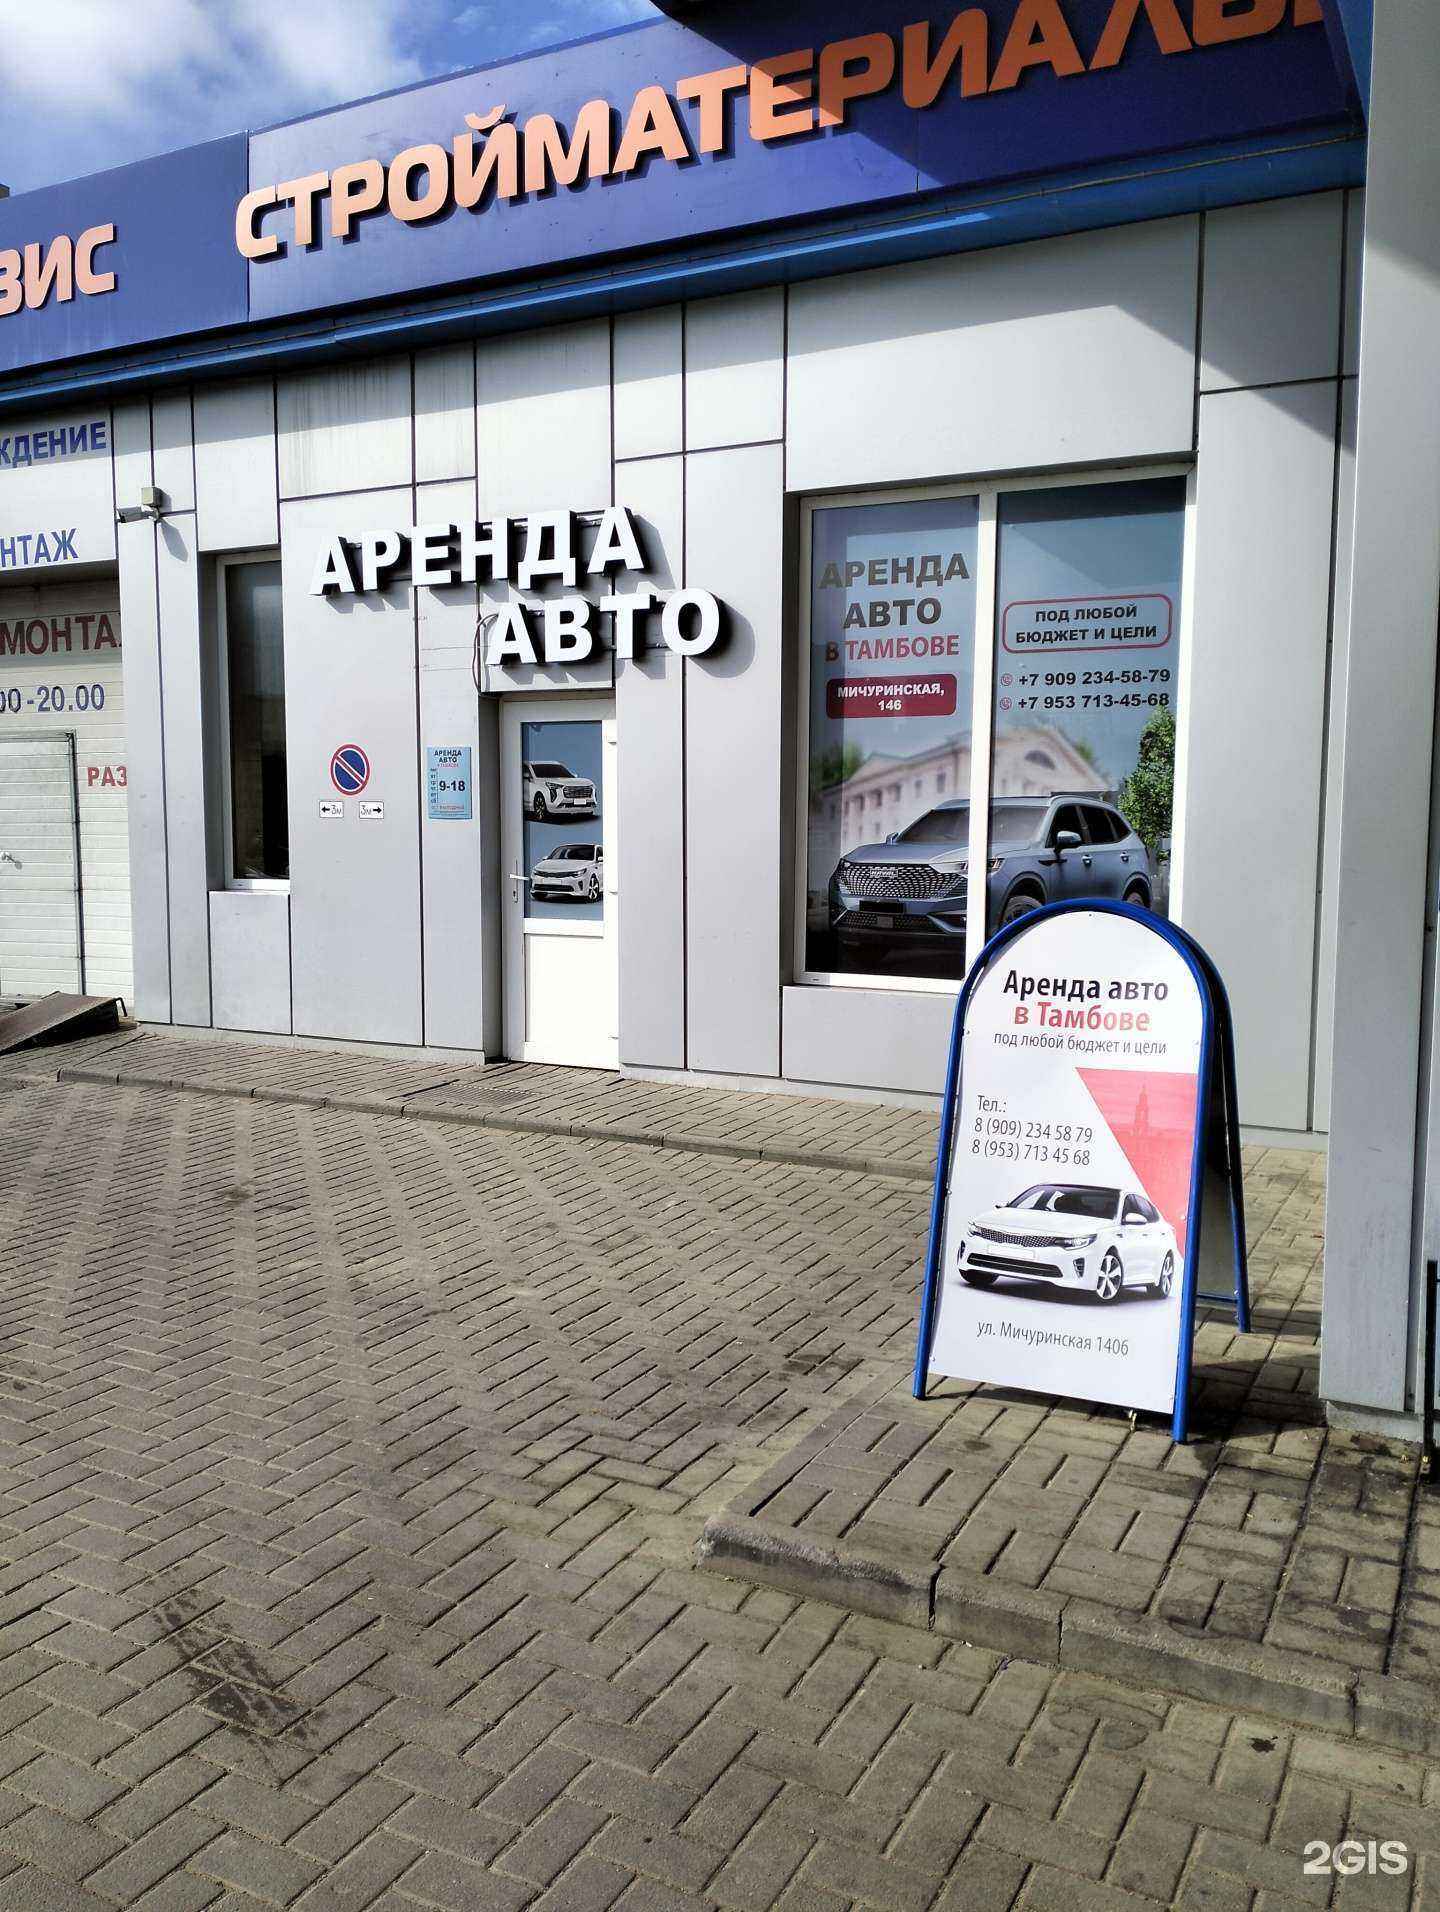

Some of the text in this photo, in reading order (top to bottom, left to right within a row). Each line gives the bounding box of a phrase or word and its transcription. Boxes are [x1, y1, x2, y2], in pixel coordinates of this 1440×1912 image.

[0, 528, 79, 567] НТАЖ
[308, 506, 645, 595] АРЕНДА
[818, 553, 970, 589] АРЕНДА
[843, 597, 942, 629] АВТО
[1035, 604, 1138, 624] ПОД ЛЮБОЙ
[0, 614, 122, 656] МОНТА
[485, 588, 720, 665] АВТО
[1016, 625, 1157, 645] БЮДЖЕТ И ЦЕЛИ
[843, 634, 960, 660] ТАМБОВЕ
[837, 682, 945, 698] МИЧУРИНСКАЯ,
[1019, 668, 1171, 687] +7 909 234-58-79
[1018, 693, 1170, 710] +7 953 713-45-68
[434, 749, 462, 757] АРЕНДА
[439, 781, 466, 792] 9-18
[1003, 969, 1169, 1003] Аренда авто
[1014, 1001, 1151, 1032] в Тамбове
[994, 1032, 1167, 1056] под любой бюджет и цели
[977, 1094, 1007, 1113] Тел.:
[974, 1117, 1093, 1143] 8 (909) 234 58 79
[972, 1138, 1091, 1166] 8 (953) 713 45 68
[976, 1321, 997, 1338] ул.
[1000, 1321, 1092, 1351] Мичуринская
